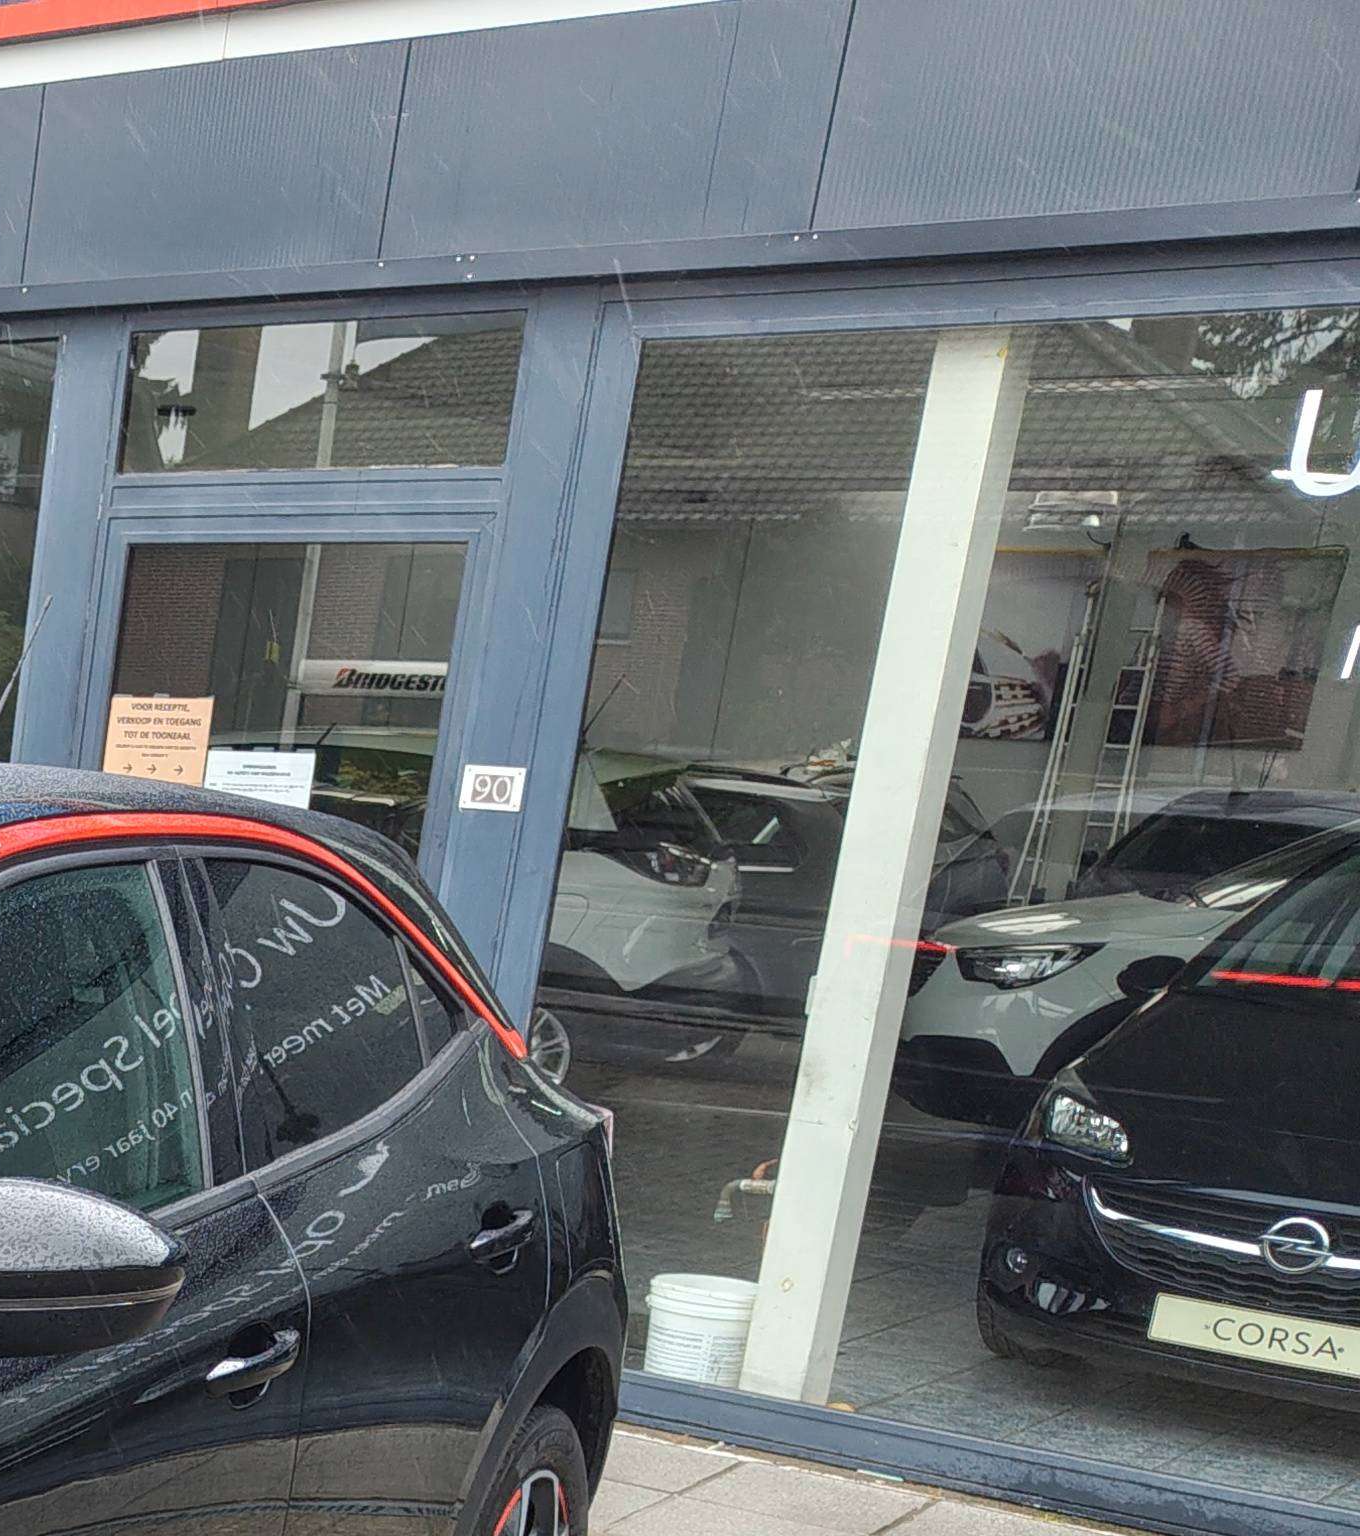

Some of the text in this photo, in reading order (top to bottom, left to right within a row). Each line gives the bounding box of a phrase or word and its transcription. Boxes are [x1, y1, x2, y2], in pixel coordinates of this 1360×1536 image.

[131, 702, 153, 711] VOOR
[117, 717, 202, 727] VERKOOP EN TOEGANG
[124, 730, 192, 741] TOT DE TOONZAAL
[475, 775, 512, 803] 90
[1212, 1317, 1338, 1362] CORSA
